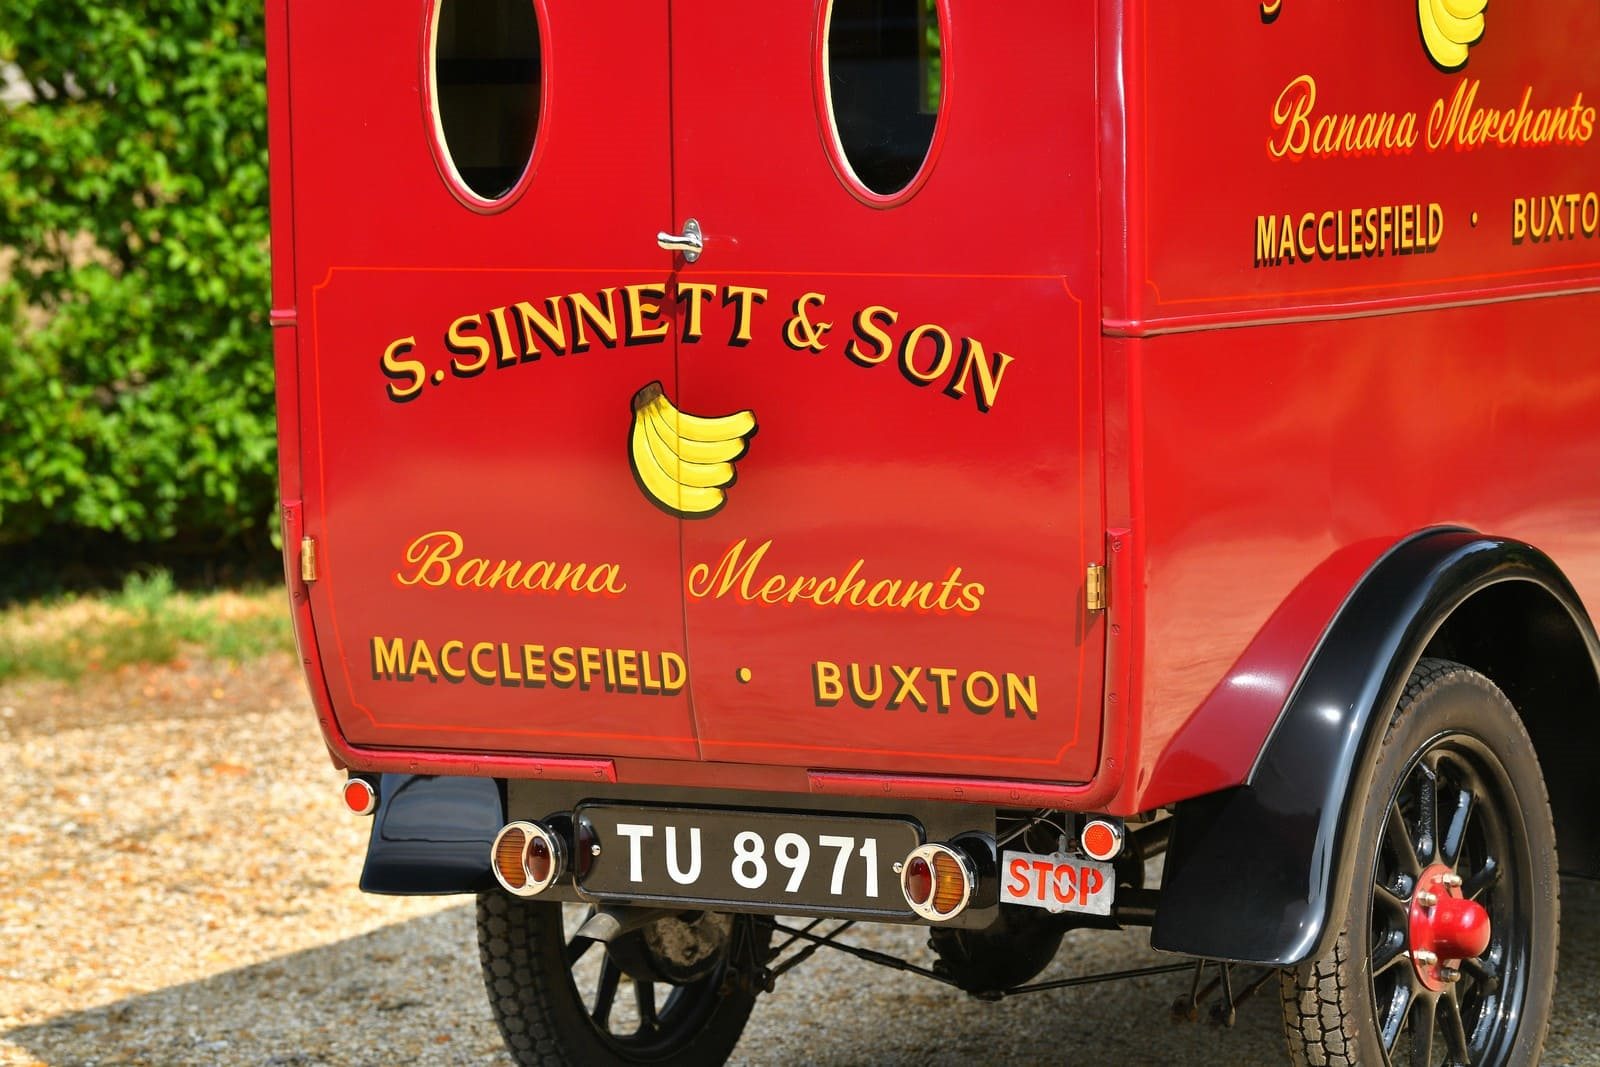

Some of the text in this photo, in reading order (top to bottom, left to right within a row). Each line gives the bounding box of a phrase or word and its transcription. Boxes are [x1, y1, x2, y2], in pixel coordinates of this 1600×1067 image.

[1267, 75, 1596, 161] Banana Merchants
[1254, 192, 1600, 268] MACCLESFIELD BUXTO
[784, 291, 832, 351] &
[847, 305, 1014, 413] SON
[397, 531, 986, 614] Banana Merchants
[371, 636, 1039, 718] MACCLESFIELD BUXTON
[616, 824, 880, 898] TU 8971
[1007, 856, 1103, 906] STOP
